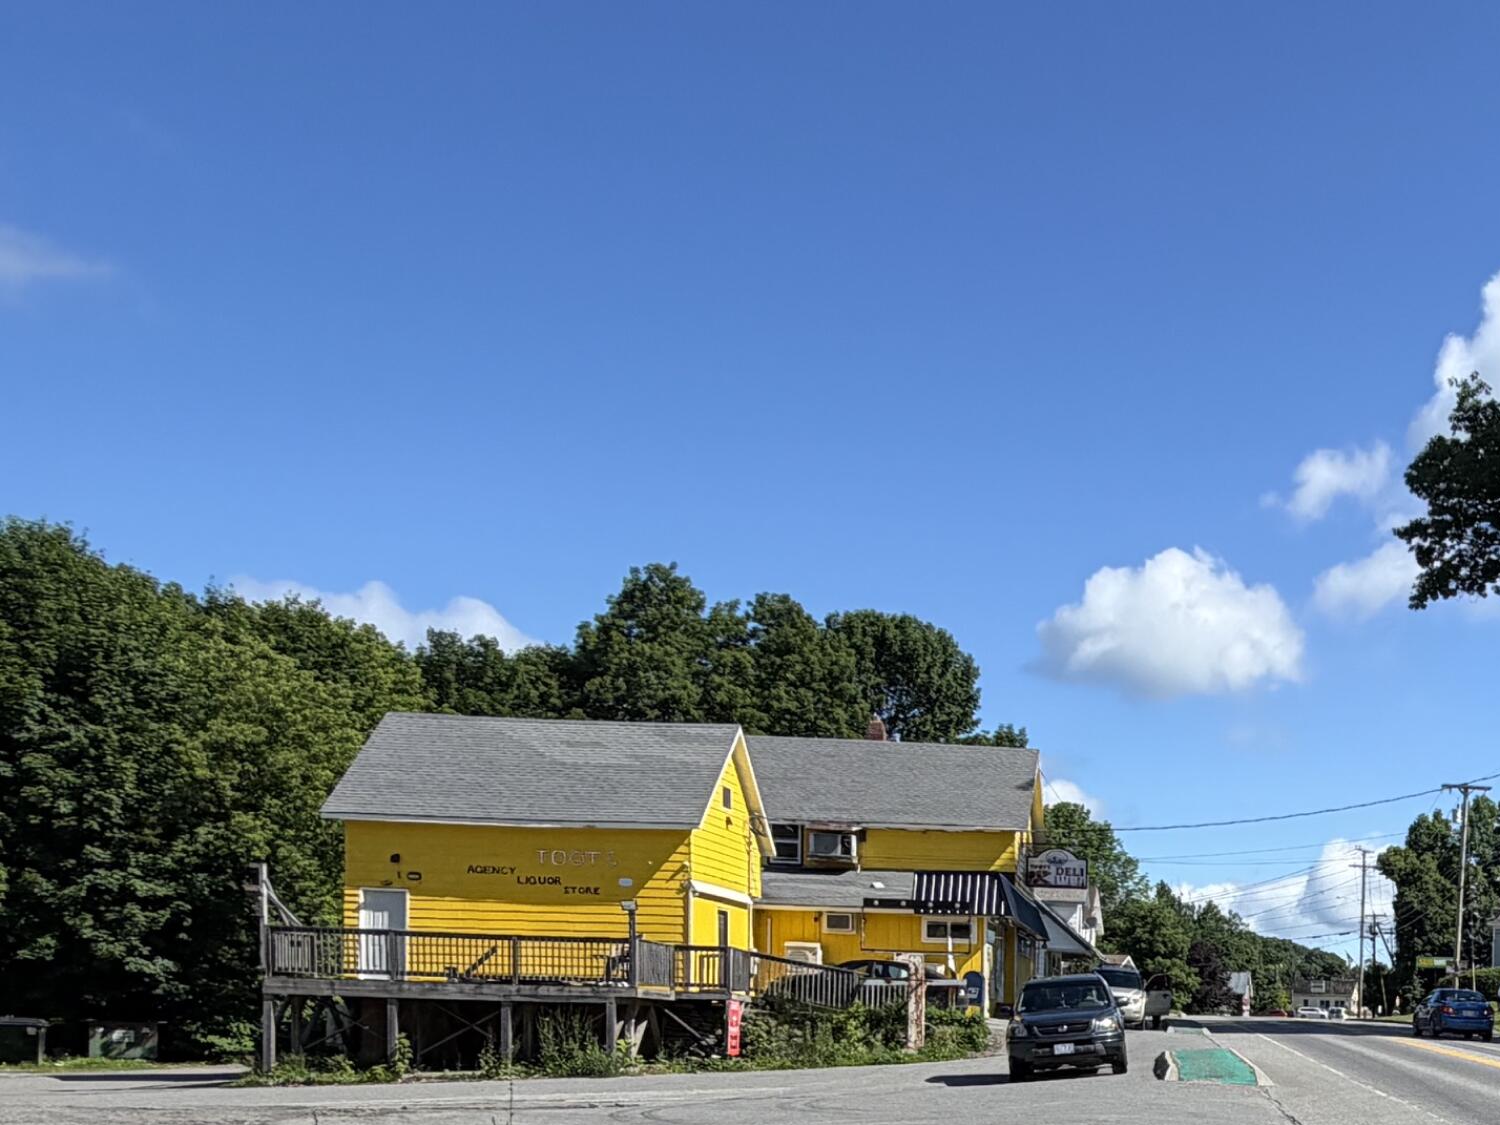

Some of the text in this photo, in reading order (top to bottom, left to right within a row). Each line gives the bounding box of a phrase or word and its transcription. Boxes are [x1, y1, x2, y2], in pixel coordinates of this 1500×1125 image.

[467, 864, 516, 875] AGENCY
[1056, 867, 1084, 877] DELI
[517, 875, 561, 886] LIQUOR
[563, 887, 601, 895] STORE
